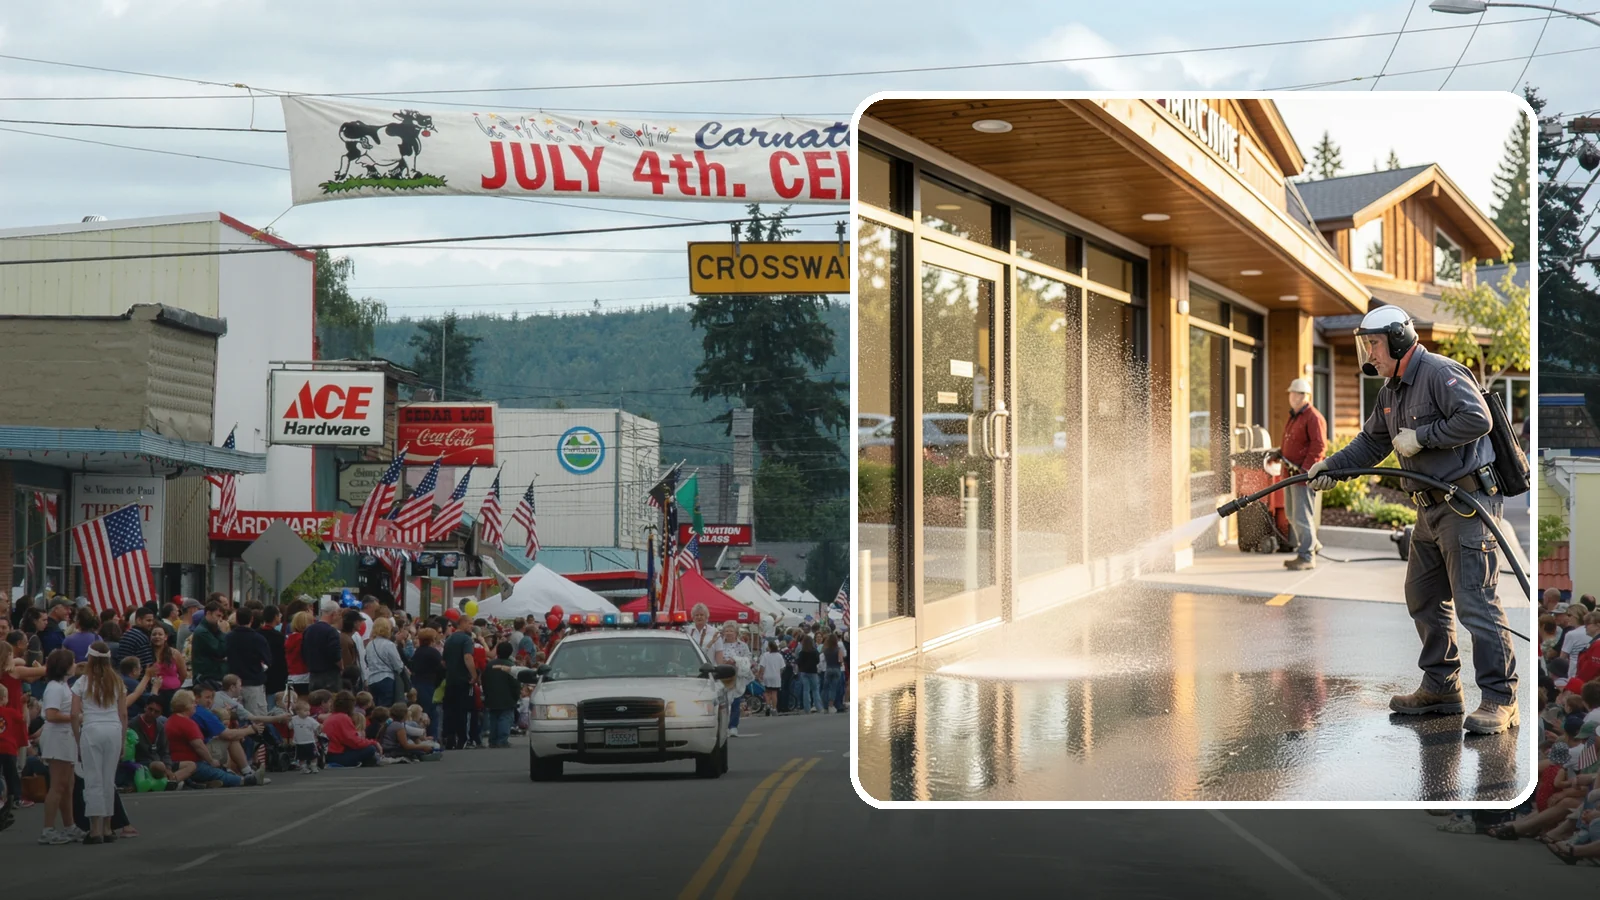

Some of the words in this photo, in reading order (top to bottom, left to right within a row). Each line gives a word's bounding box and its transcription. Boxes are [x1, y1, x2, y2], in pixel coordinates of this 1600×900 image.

[481, 141, 605, 192] JULY
[632, 150, 746, 197] 4th.
[697, 254, 850, 279] CROSSWA
[282, 380, 374, 420] ACE
[405, 409, 453, 421] CEDAR
[461, 409, 485, 421] LOG
[283, 421, 371, 436] Hardware
[416, 428, 476, 446] Coca-Cola
[95, 485, 124, 494] Vincent
[126, 486, 136, 494] de
[137, 486, 155, 495] Paul
[688, 527, 741, 535] CRNATION
[699, 535, 730, 543] GLASS
